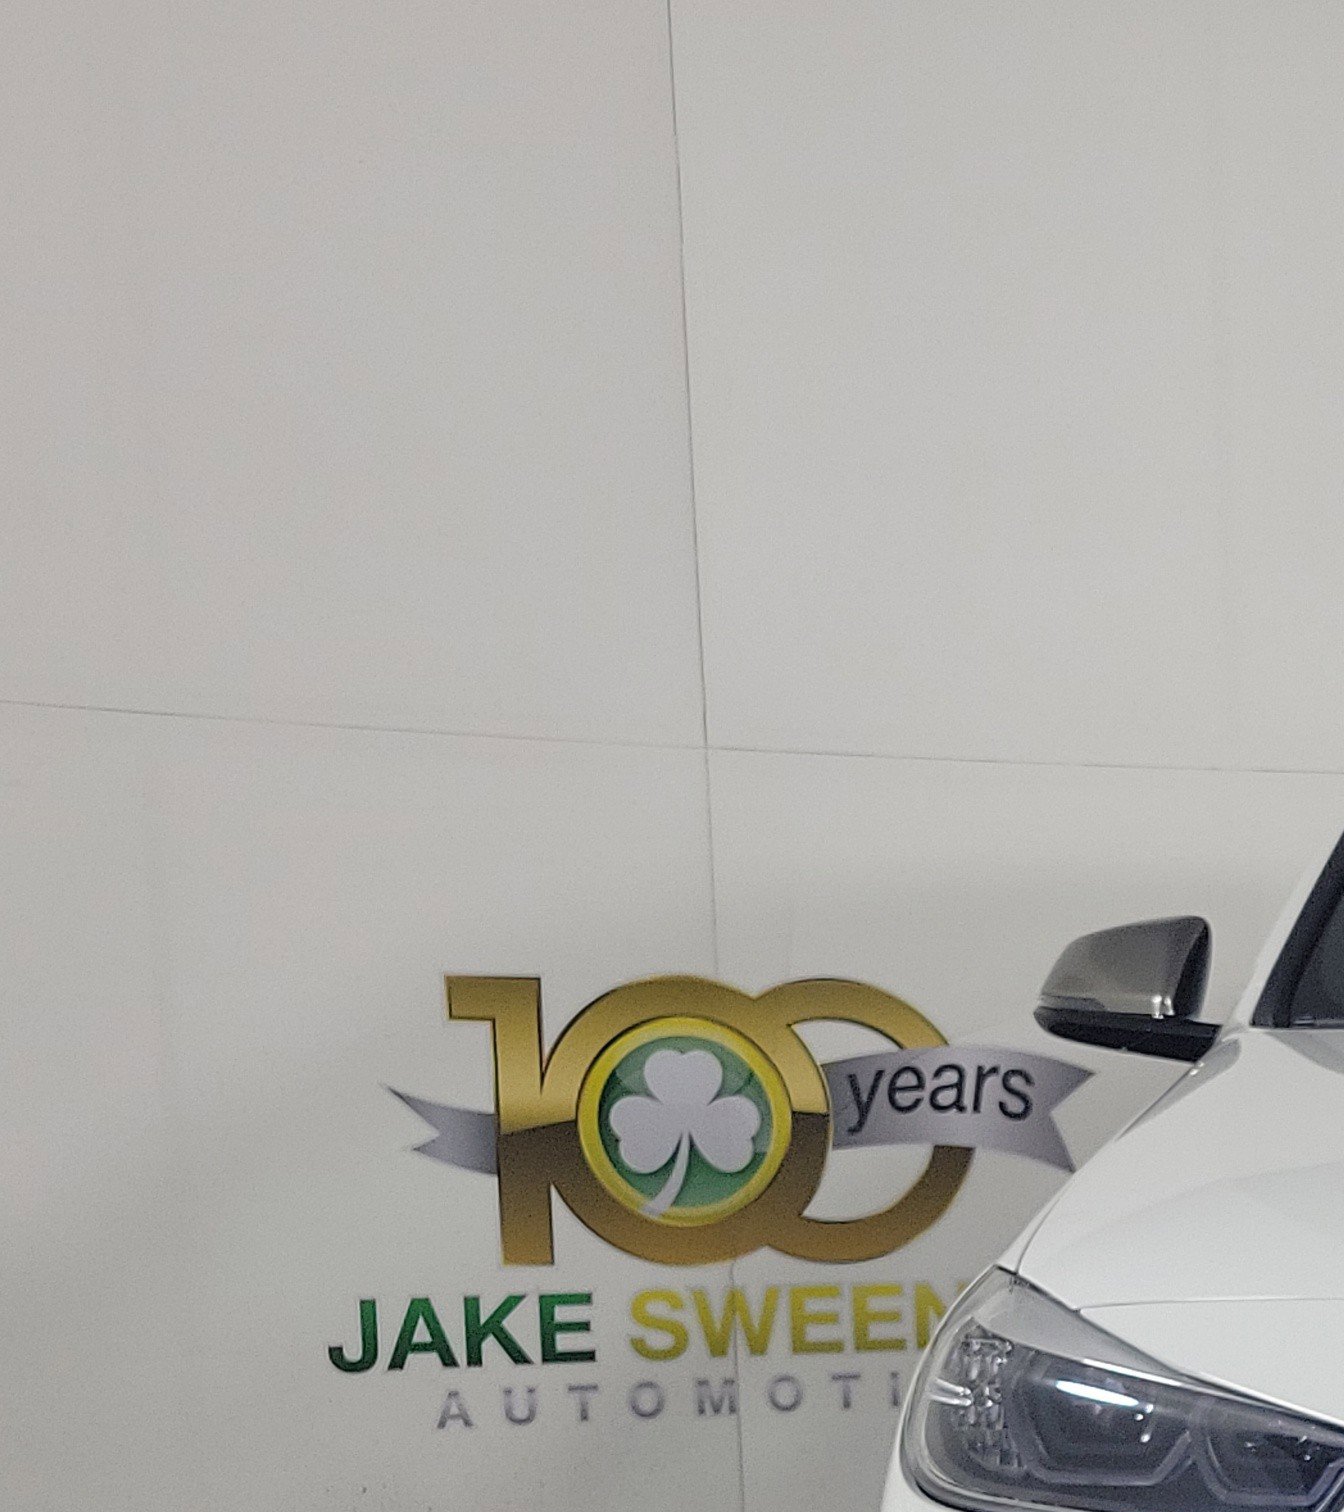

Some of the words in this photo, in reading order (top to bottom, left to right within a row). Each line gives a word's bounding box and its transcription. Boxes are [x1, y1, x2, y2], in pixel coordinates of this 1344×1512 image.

[444, 974, 975, 1266] 100
[845, 1060, 1035, 1134] years
[328, 1292, 597, 1374] JAKE
[629, 1281, 967, 1362] SWEEN
[436, 1370, 901, 1430] AUTOMOTI
